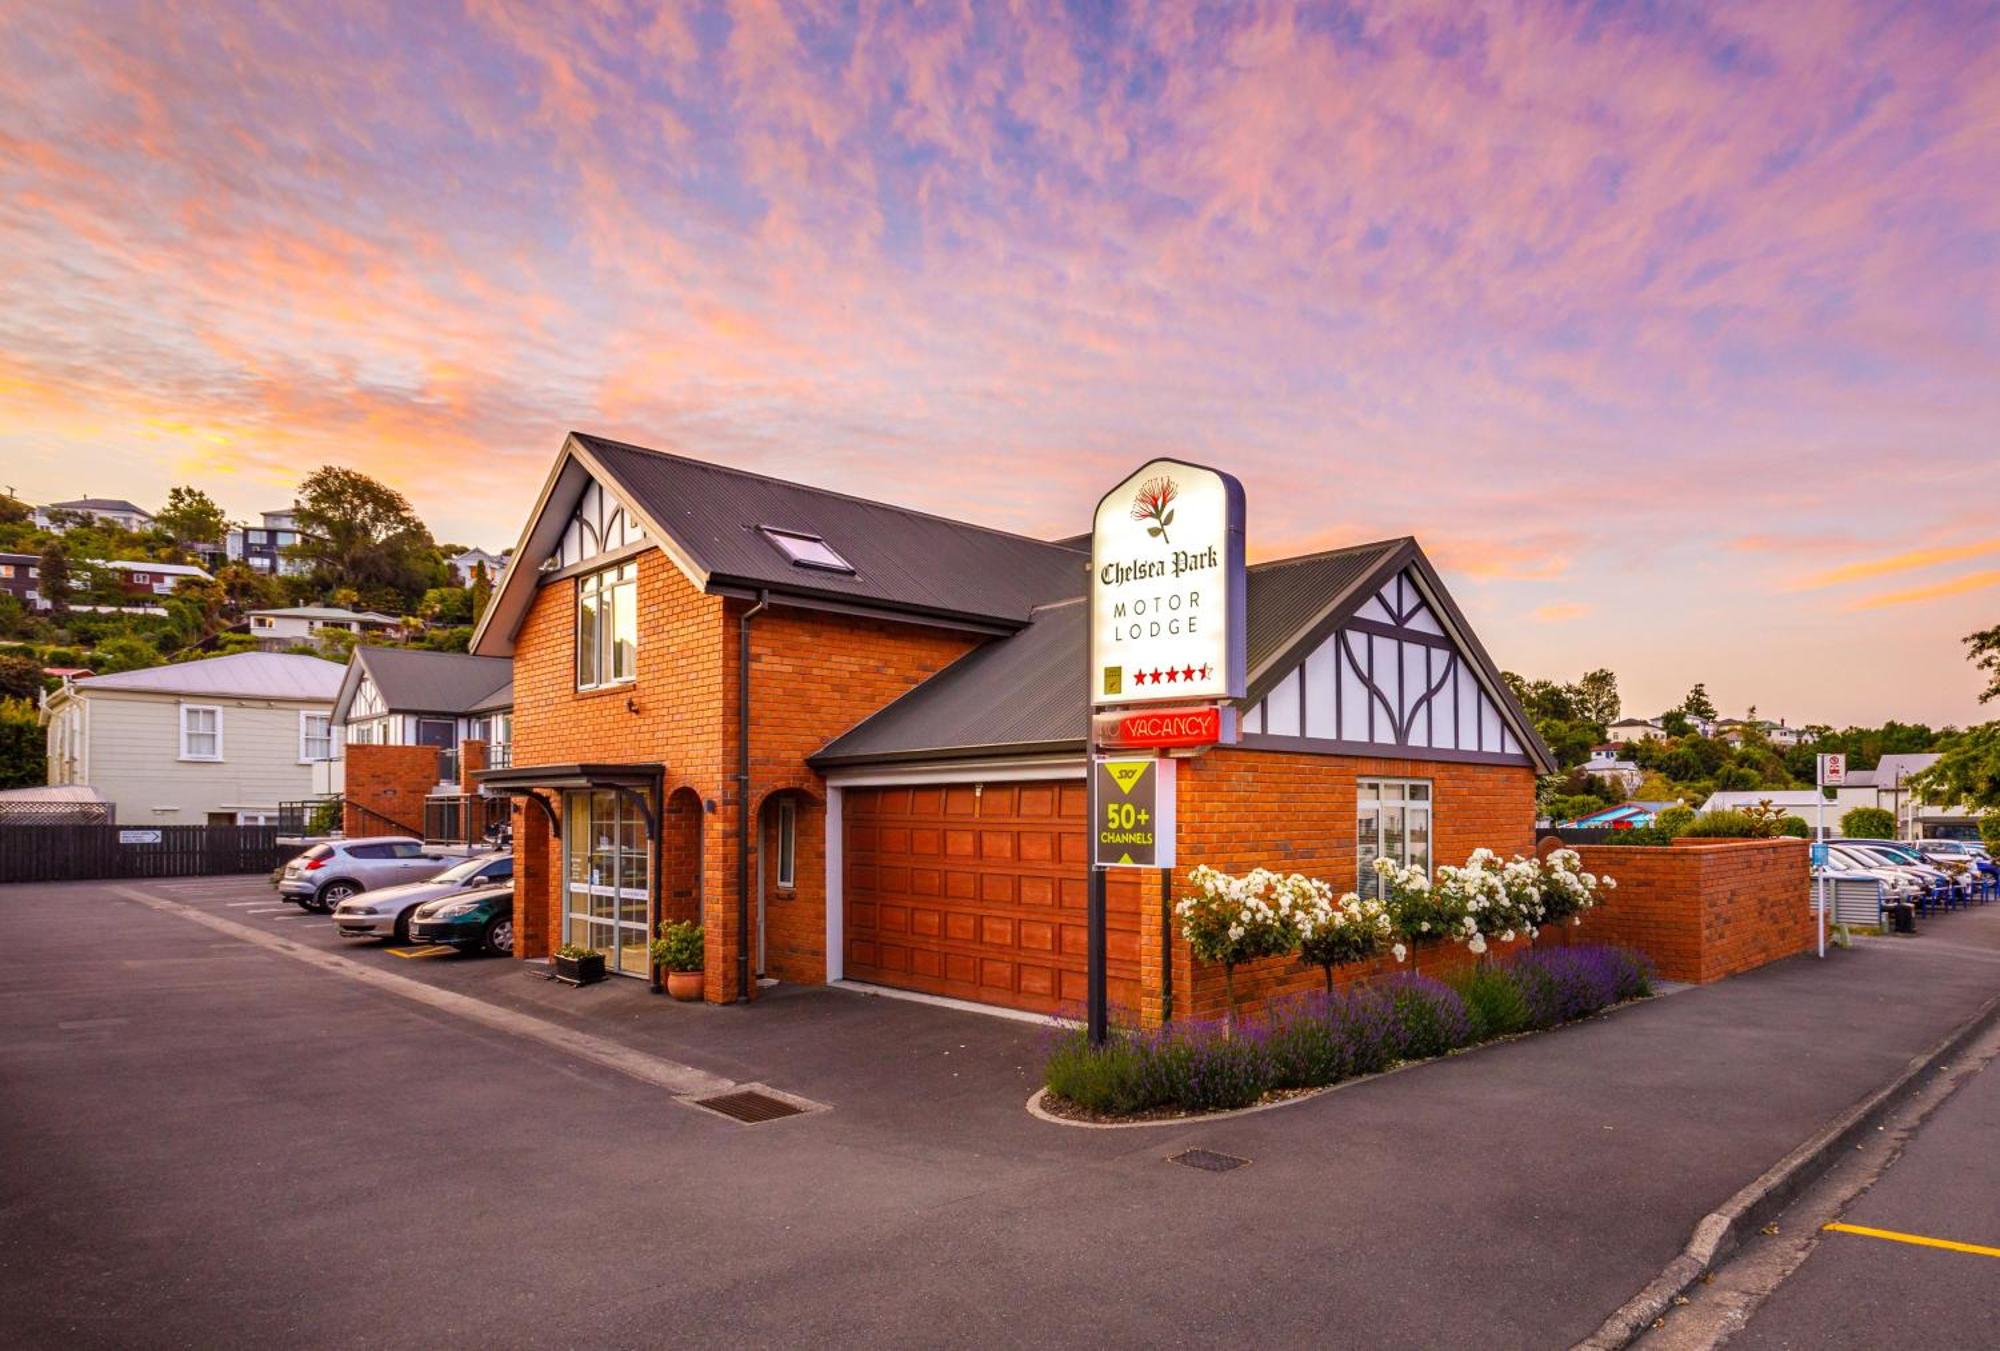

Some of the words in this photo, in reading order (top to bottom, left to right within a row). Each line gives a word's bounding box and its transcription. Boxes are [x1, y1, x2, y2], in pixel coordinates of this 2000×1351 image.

[1100, 559, 1165, 587] Chelsea
[1171, 545, 1218, 578] Park
[1113, 591, 1200, 619] MOTOR
[1115, 616, 1197, 642] LODGE
[1126, 716, 1211, 737] VACANCY
[1107, 803, 1150, 830] 50+
[1100, 832, 1153, 844] CHANNELS
